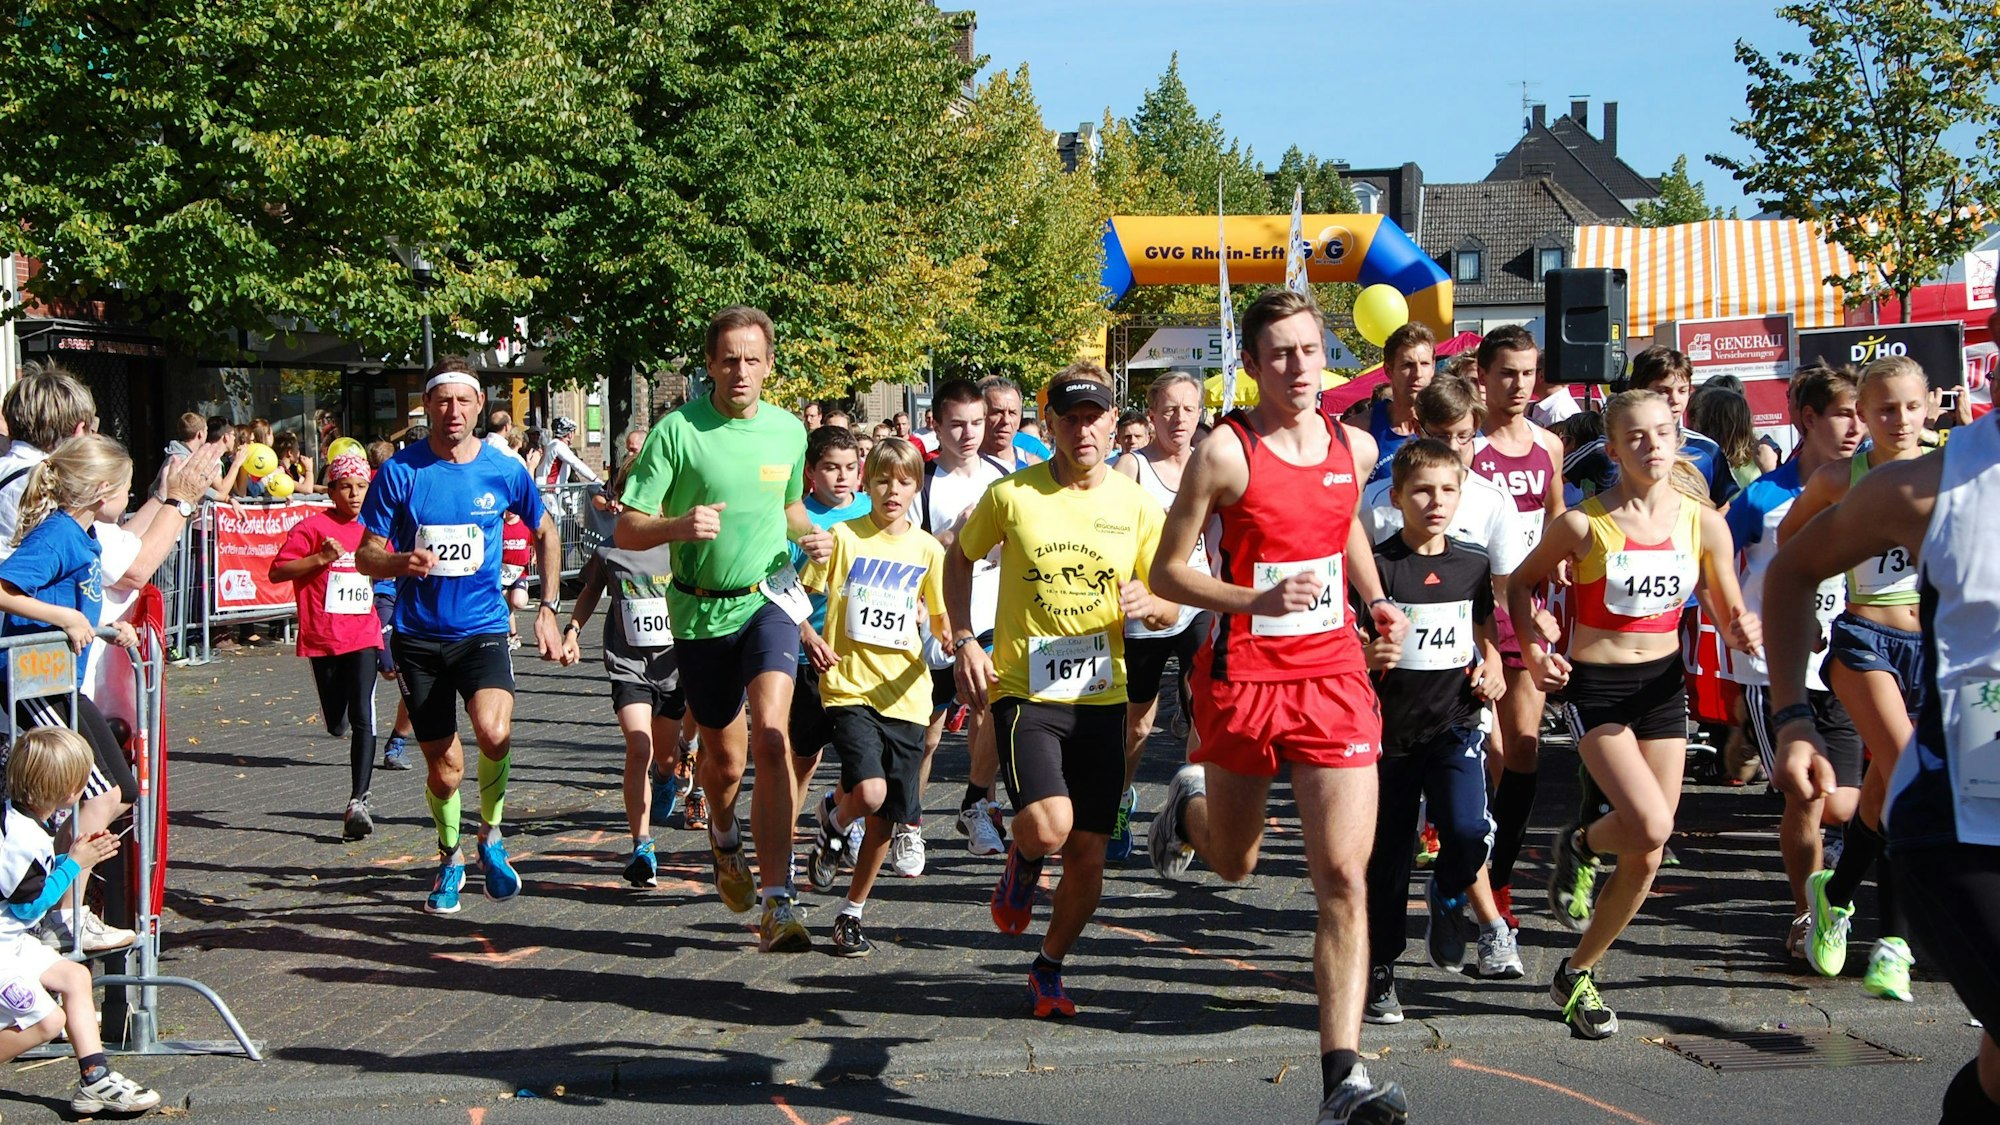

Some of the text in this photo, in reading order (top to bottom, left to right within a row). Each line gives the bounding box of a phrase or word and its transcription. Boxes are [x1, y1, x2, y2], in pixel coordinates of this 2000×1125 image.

[1145, 245, 1285, 260] GVG Rhin-Erft
[1714, 333, 1783, 351] GENERALI
[1714, 350, 1775, 360] Versicherungen
[1066, 384, 1092, 393] CRAFT
[1492, 470, 1546, 496] ASV
[1034, 541, 1104, 562] Zülpicher
[845, 556, 928, 593] NIKE
[1624, 575, 1681, 597] 1453
[338, 588, 369, 601] 1166
[1033, 593, 1102, 617] Triathlon
[859, 606, 906, 632] 1351
[1415, 626, 1456, 650] 744
[19, 649, 67, 681] step
[1045, 655, 1097, 681] 1671
